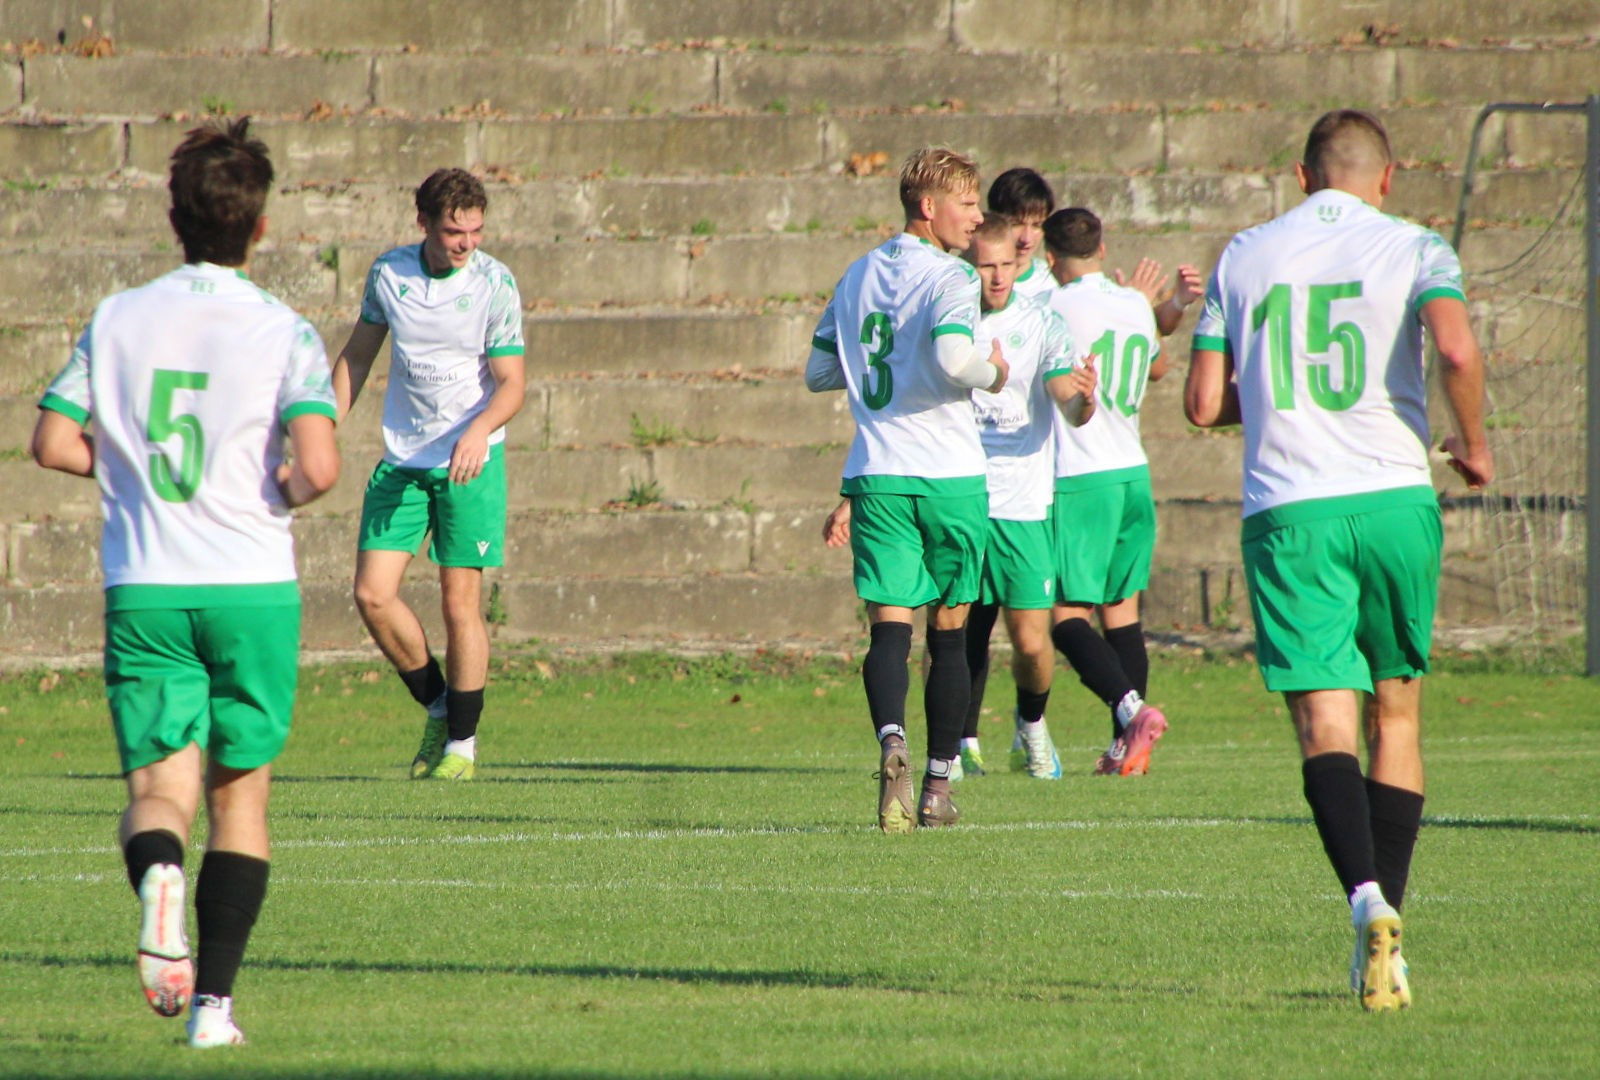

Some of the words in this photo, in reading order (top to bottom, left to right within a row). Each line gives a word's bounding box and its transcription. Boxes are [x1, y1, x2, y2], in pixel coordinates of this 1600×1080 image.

[860, 311, 894, 411] 3
[1090, 329, 1150, 418] 10
[1252, 280, 1365, 411] 15
[147, 368, 209, 503] 5
